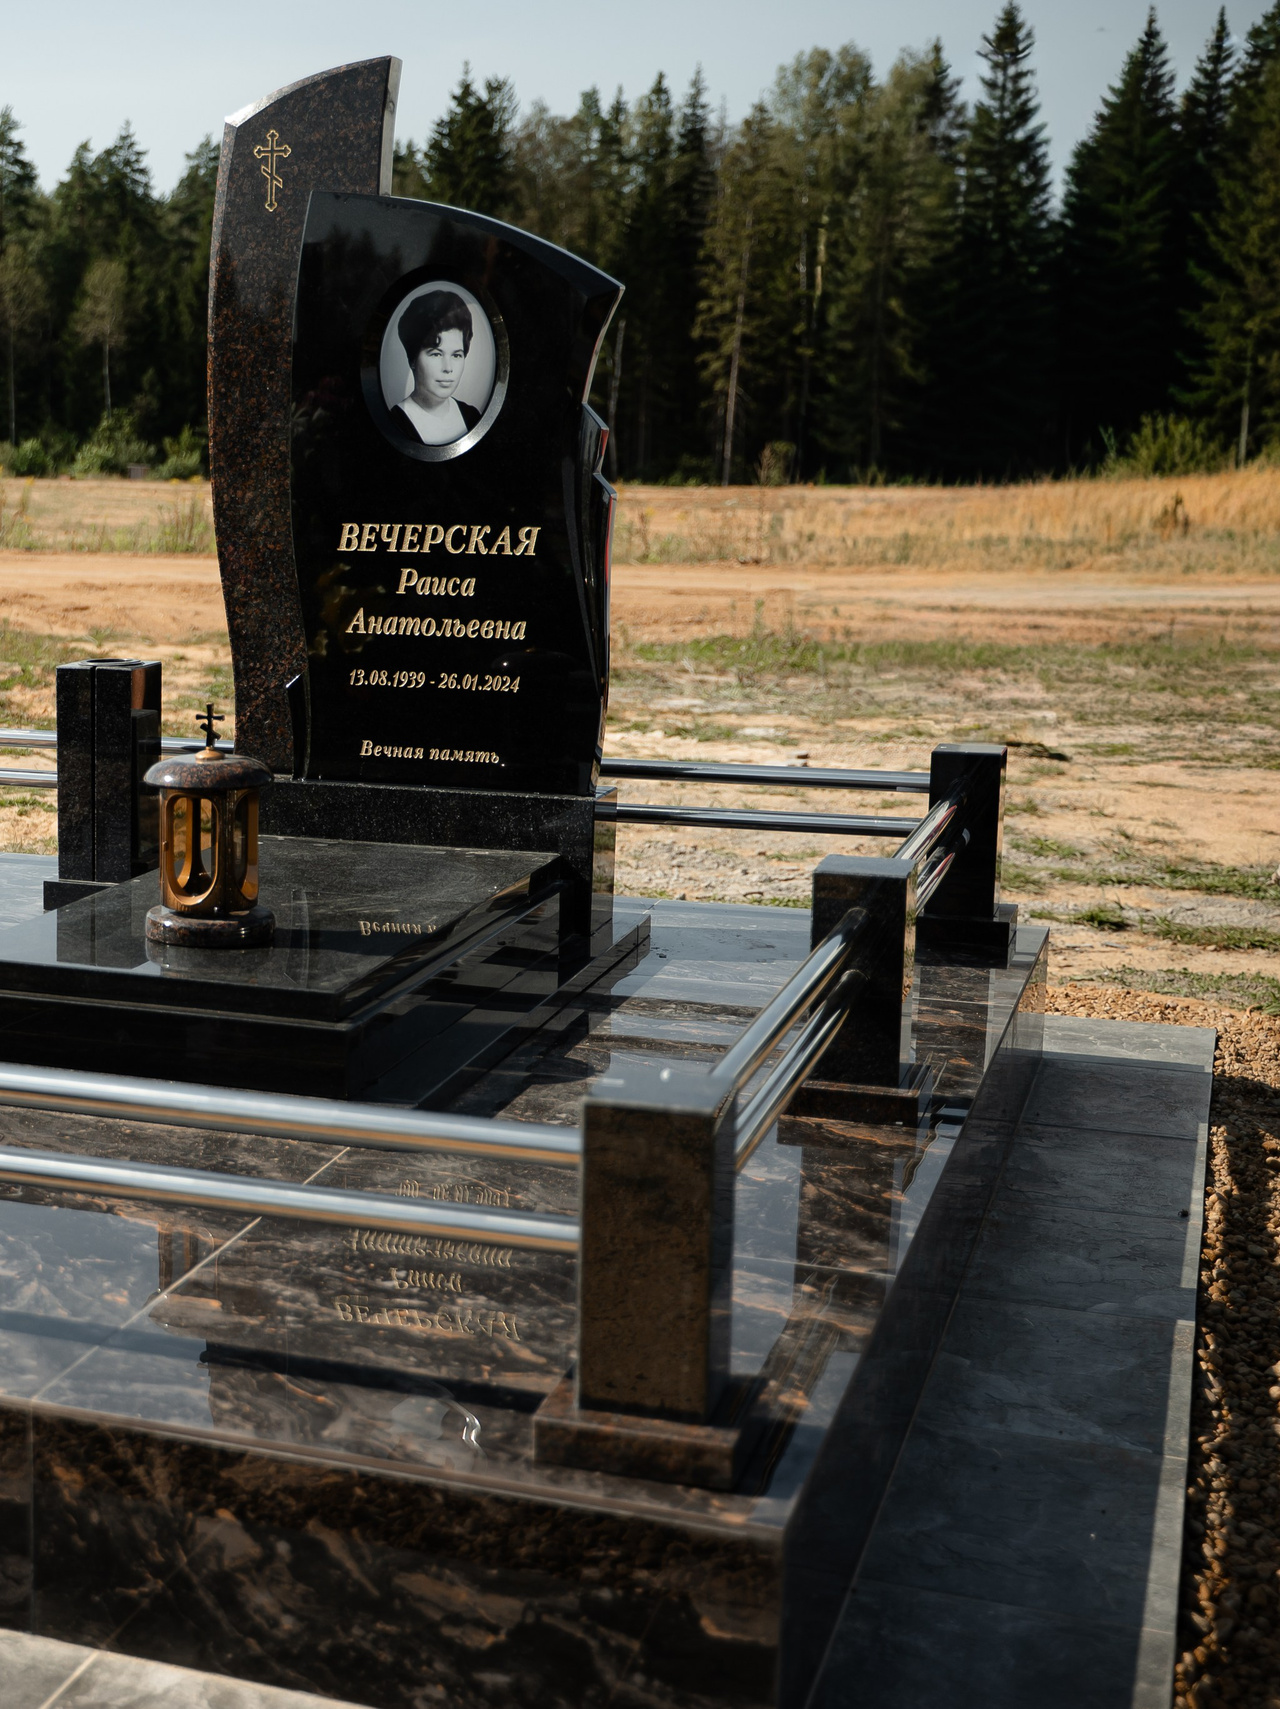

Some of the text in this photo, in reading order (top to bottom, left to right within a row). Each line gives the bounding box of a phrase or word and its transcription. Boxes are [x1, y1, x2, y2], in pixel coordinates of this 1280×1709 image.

[337, 523, 541, 556] ВЕЧЕРСКАЯ
[396, 568, 476, 597] Раиса
[345, 607, 527, 640] Анатольевна
[349, 669, 426, 689] 13.08.1939
[438, 673, 521, 693] 26.01.2024
[360, 740, 500, 764] Вечная память
